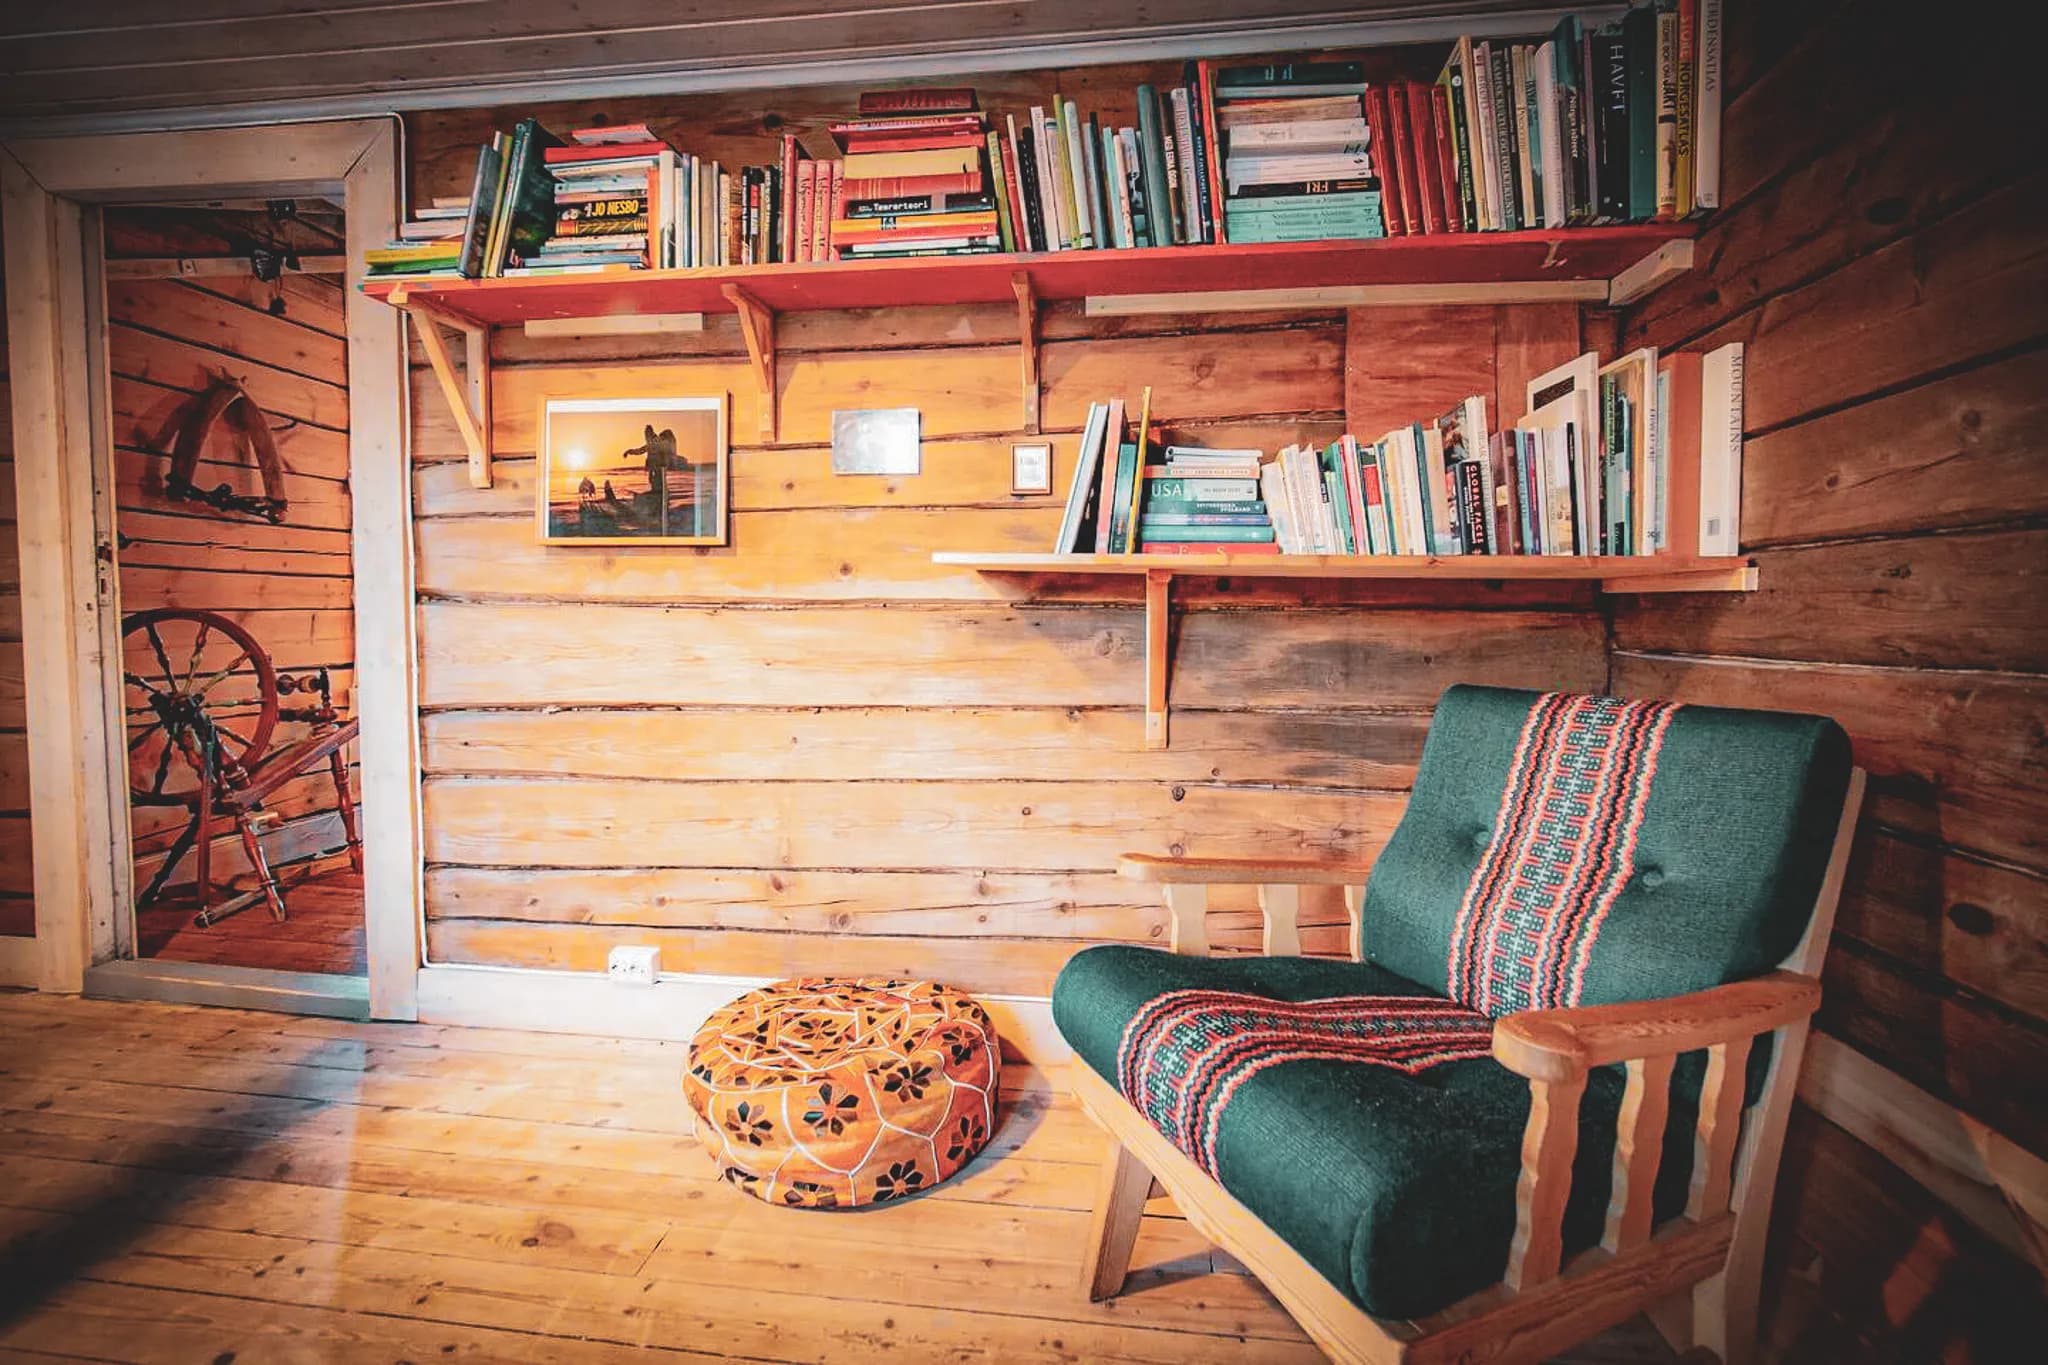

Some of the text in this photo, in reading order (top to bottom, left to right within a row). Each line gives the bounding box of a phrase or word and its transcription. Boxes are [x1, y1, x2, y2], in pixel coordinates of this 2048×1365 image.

[1705, 0, 1720, 92] ERDENSATLAS
[1679, 62, 1692, 157] NORGESATLAS
[592, 201, 606, 217] JO
[1729, 355, 1743, 454] MOUNTAINS
[1151, 483, 1182, 497] USA
[1469, 464, 1481, 508] GLOBAL
[1473, 511, 1485, 545] FACES
